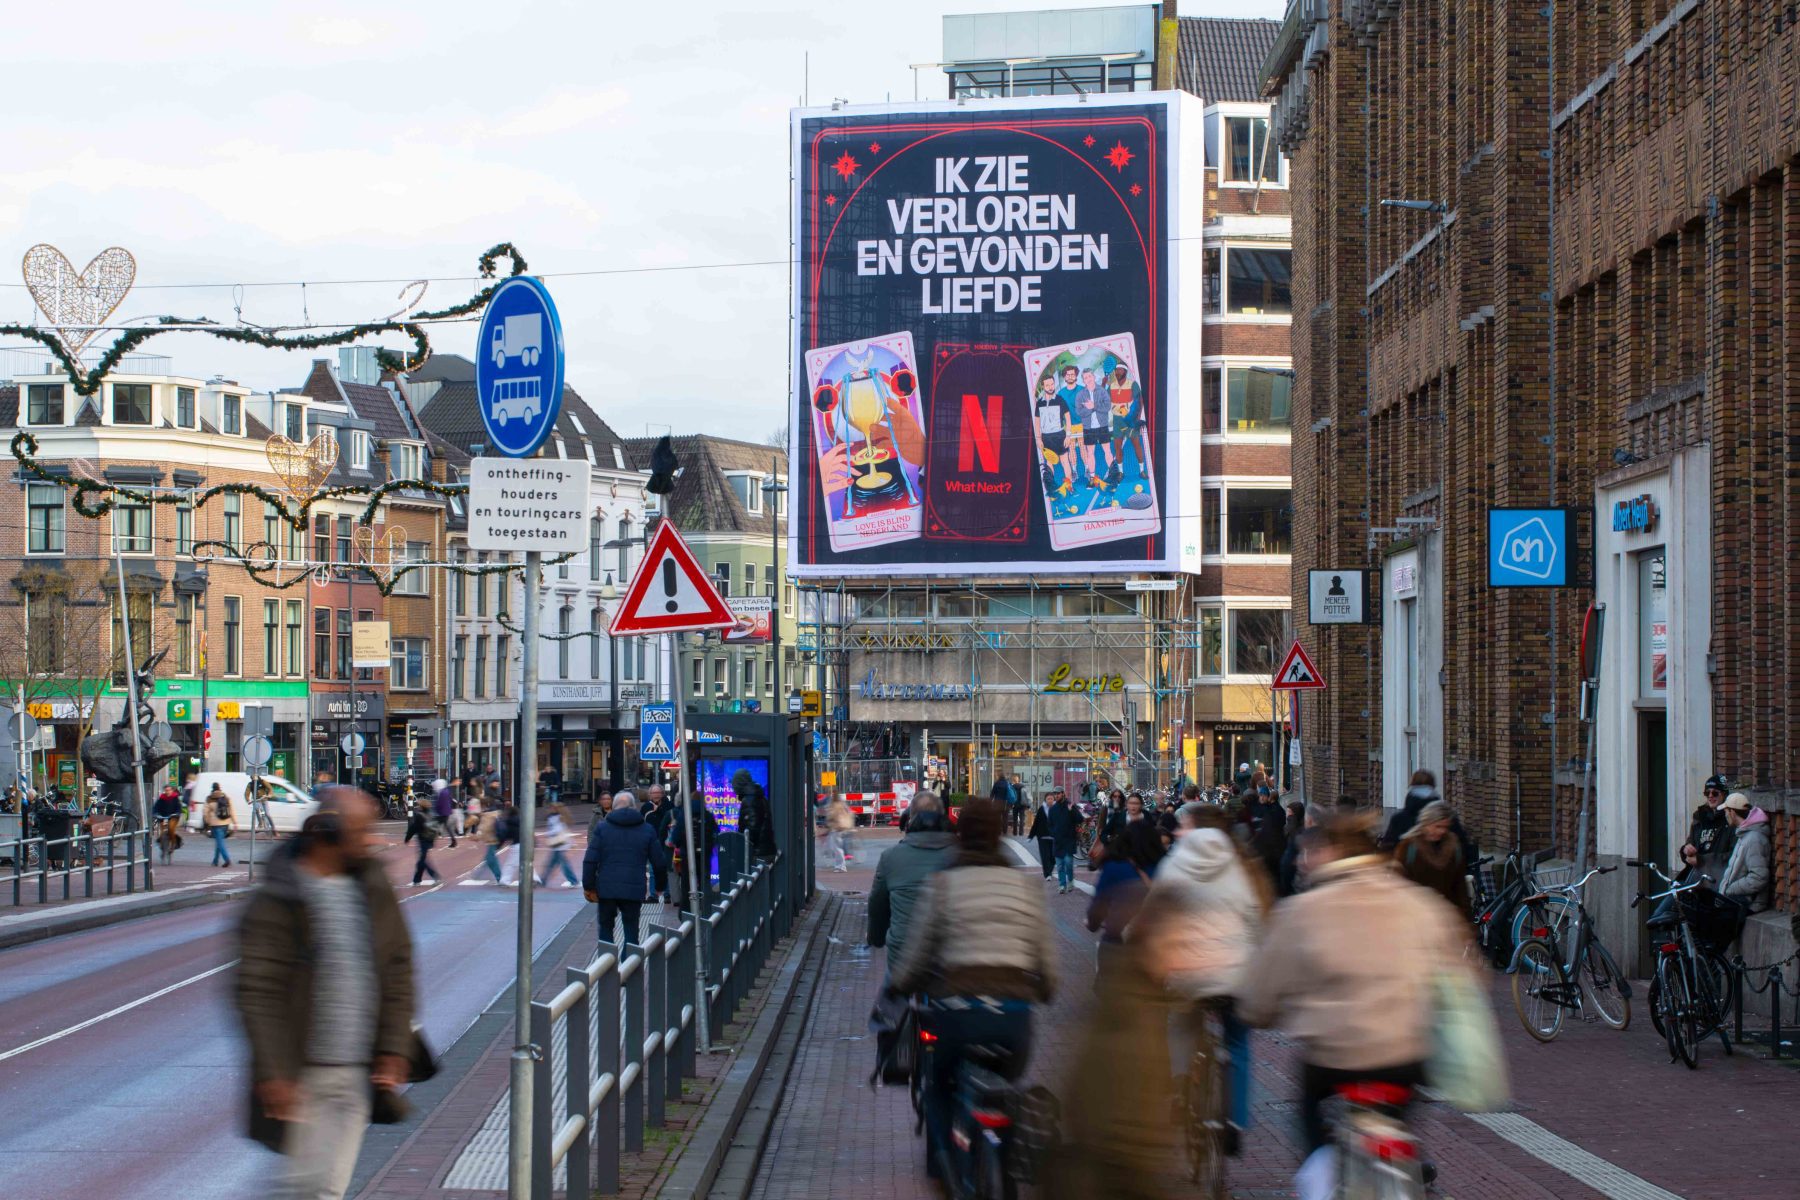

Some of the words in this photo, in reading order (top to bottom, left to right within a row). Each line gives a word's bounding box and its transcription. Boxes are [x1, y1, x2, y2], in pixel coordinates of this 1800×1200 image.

[935, 157, 969, 193] IK
[976, 155, 1029, 192] ZIE
[887, 194, 1076, 234] VERLOREN
[857, 240, 903, 276] EN
[910, 233, 1109, 274] GEVONDEN
[922, 276, 1042, 314] LIEFDE
[957, 394, 1003, 474] N
[487, 468, 572, 485] ontheffing-
[501, 489, 558, 501] houders
[945, 480, 976, 494] What
[977, 480, 1012, 494] Next?
[475, 507, 493, 518] en
[497, 506, 582, 521] touringcars
[855, 521, 877, 532] LOVE
[877, 519, 886, 528] IS
[886, 514, 911, 526] BLIND
[859, 523, 909, 538] NEDERLAND
[1083, 517, 1125, 531] HAANTJES
[488, 526, 567, 541] toegestaan
[1324, 596, 1349, 605] MENEER
[1323, 605, 1351, 615] POTTER
[858, 667, 974, 701] WATERMAN
[1044, 663, 1125, 694] Lorjé
[552, 686, 589, 698] KUNSTHANDEL
[26, 702, 94, 719] UBWAY
